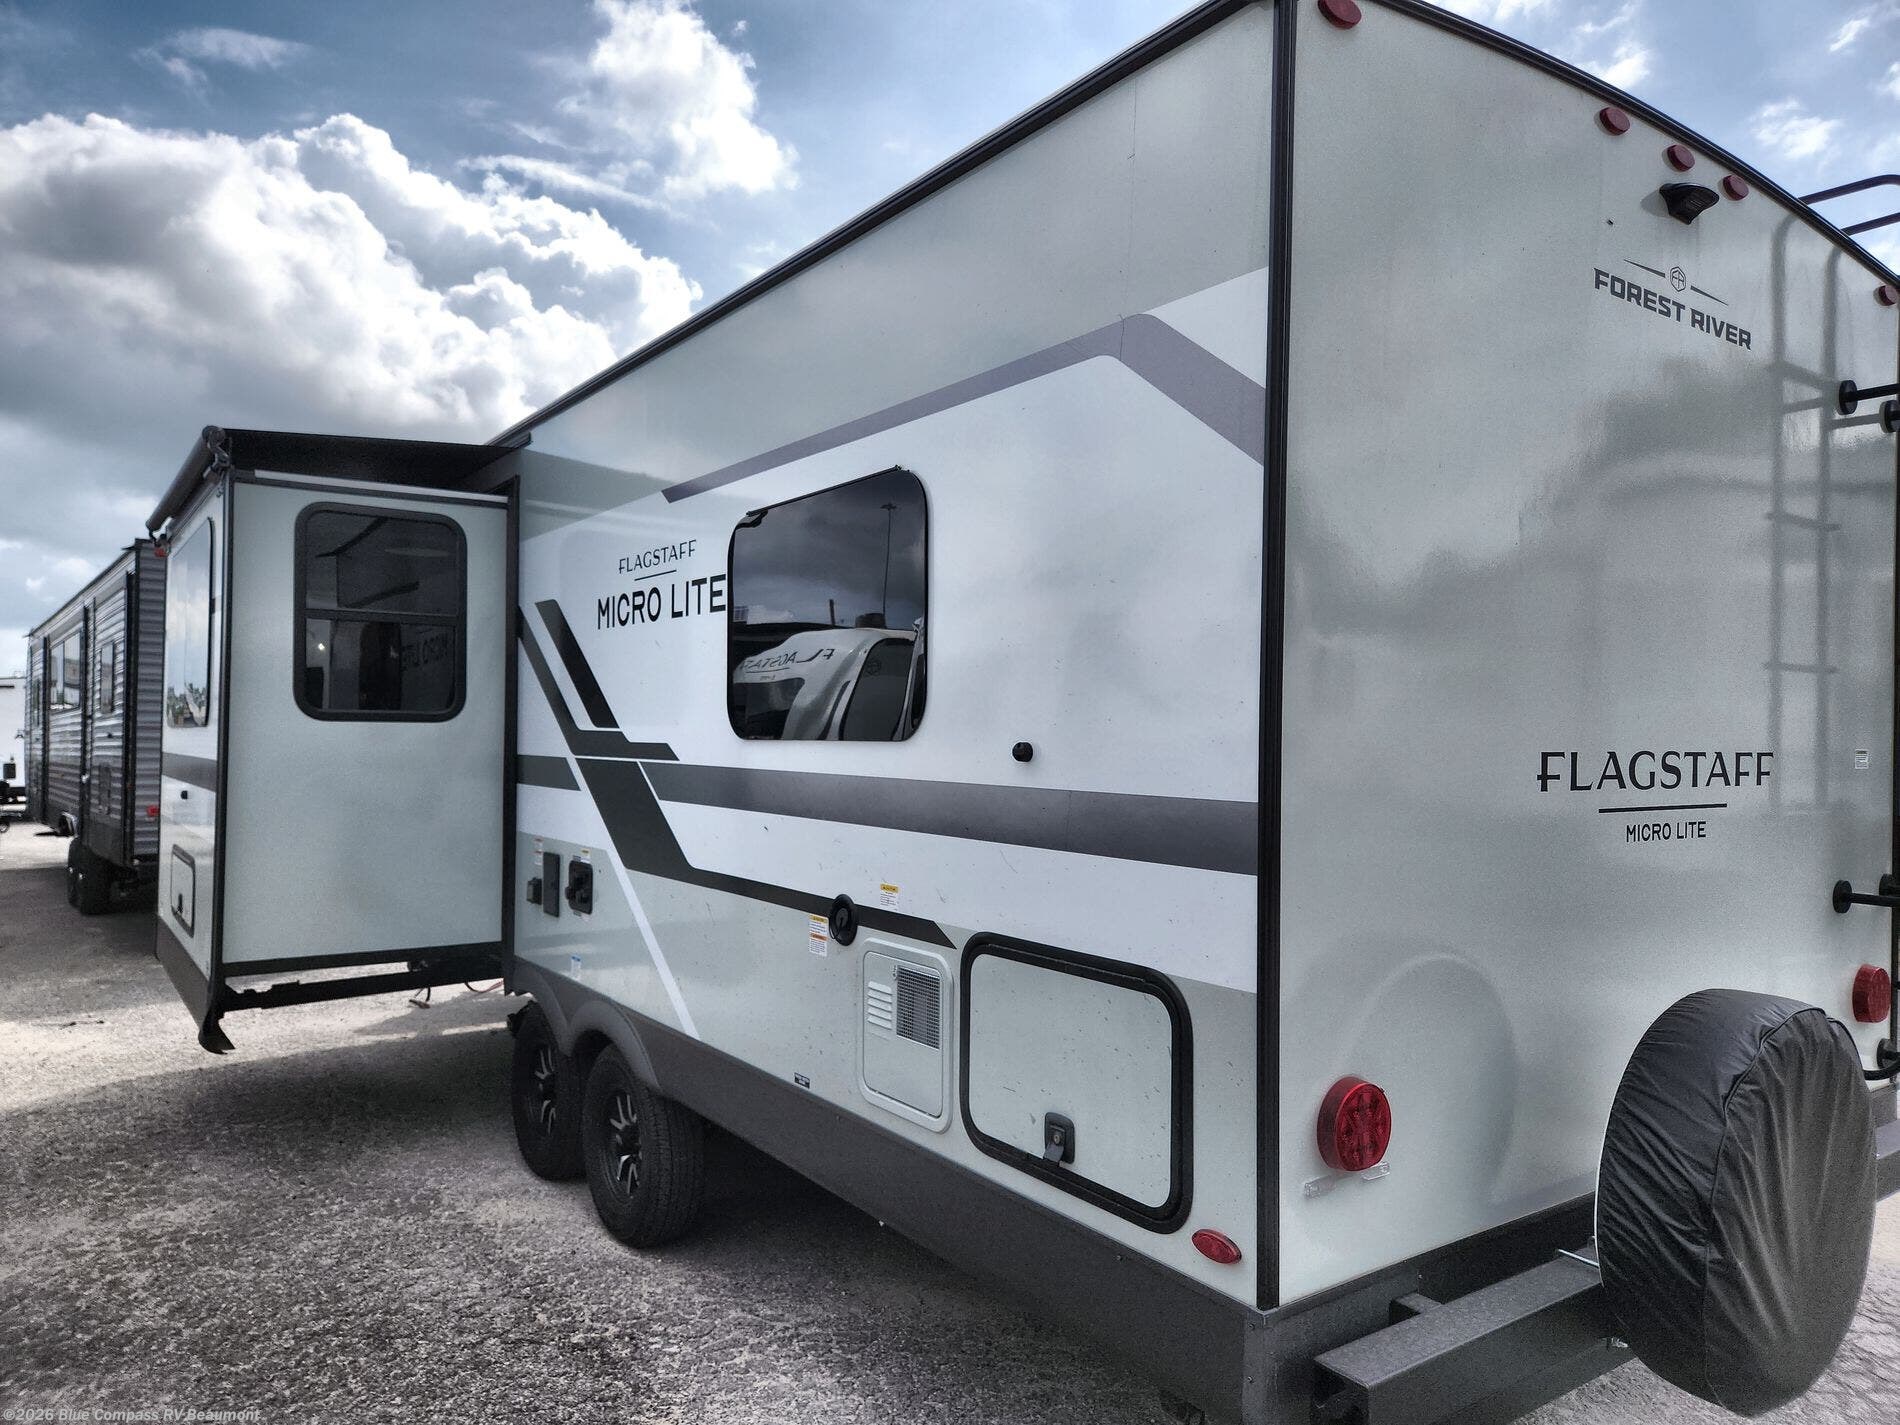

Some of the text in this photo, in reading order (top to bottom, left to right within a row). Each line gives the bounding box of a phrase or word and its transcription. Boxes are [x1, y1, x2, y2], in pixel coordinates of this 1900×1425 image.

[1594, 267, 1752, 351] FOREST RIVER
[618, 538, 697, 574] FLAGSTAFF
[597, 573, 726, 630] MICRO LITE
[1537, 750, 1774, 792] FLAGSTAFF
[1626, 820, 1707, 843] MICRO LITE
